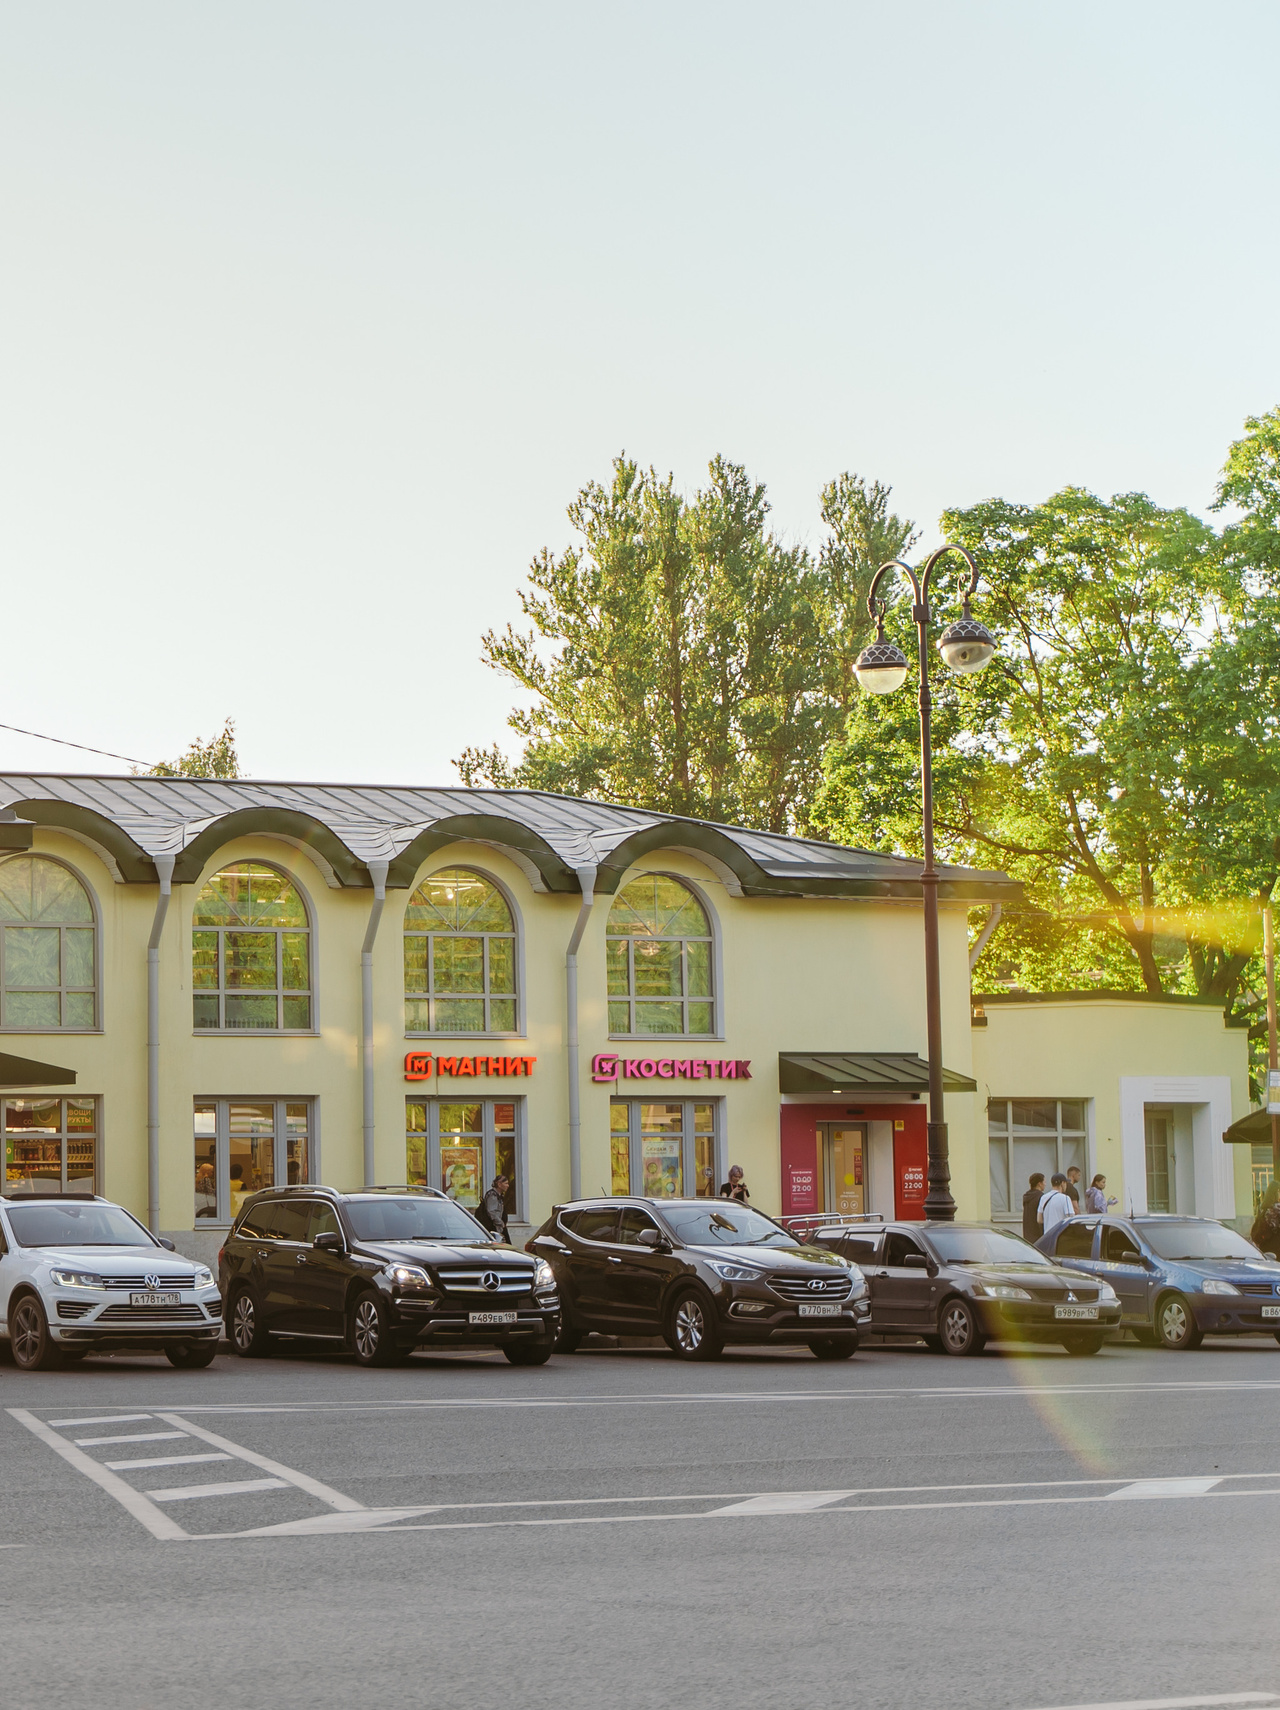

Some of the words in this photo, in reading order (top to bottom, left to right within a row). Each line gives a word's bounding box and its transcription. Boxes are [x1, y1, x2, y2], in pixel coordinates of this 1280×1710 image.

[436, 1056, 537, 1076] МАГНИТ
[623, 1059, 753, 1079] КОСМЕТИК
[134, 1295, 165, 1304] А178ТН
